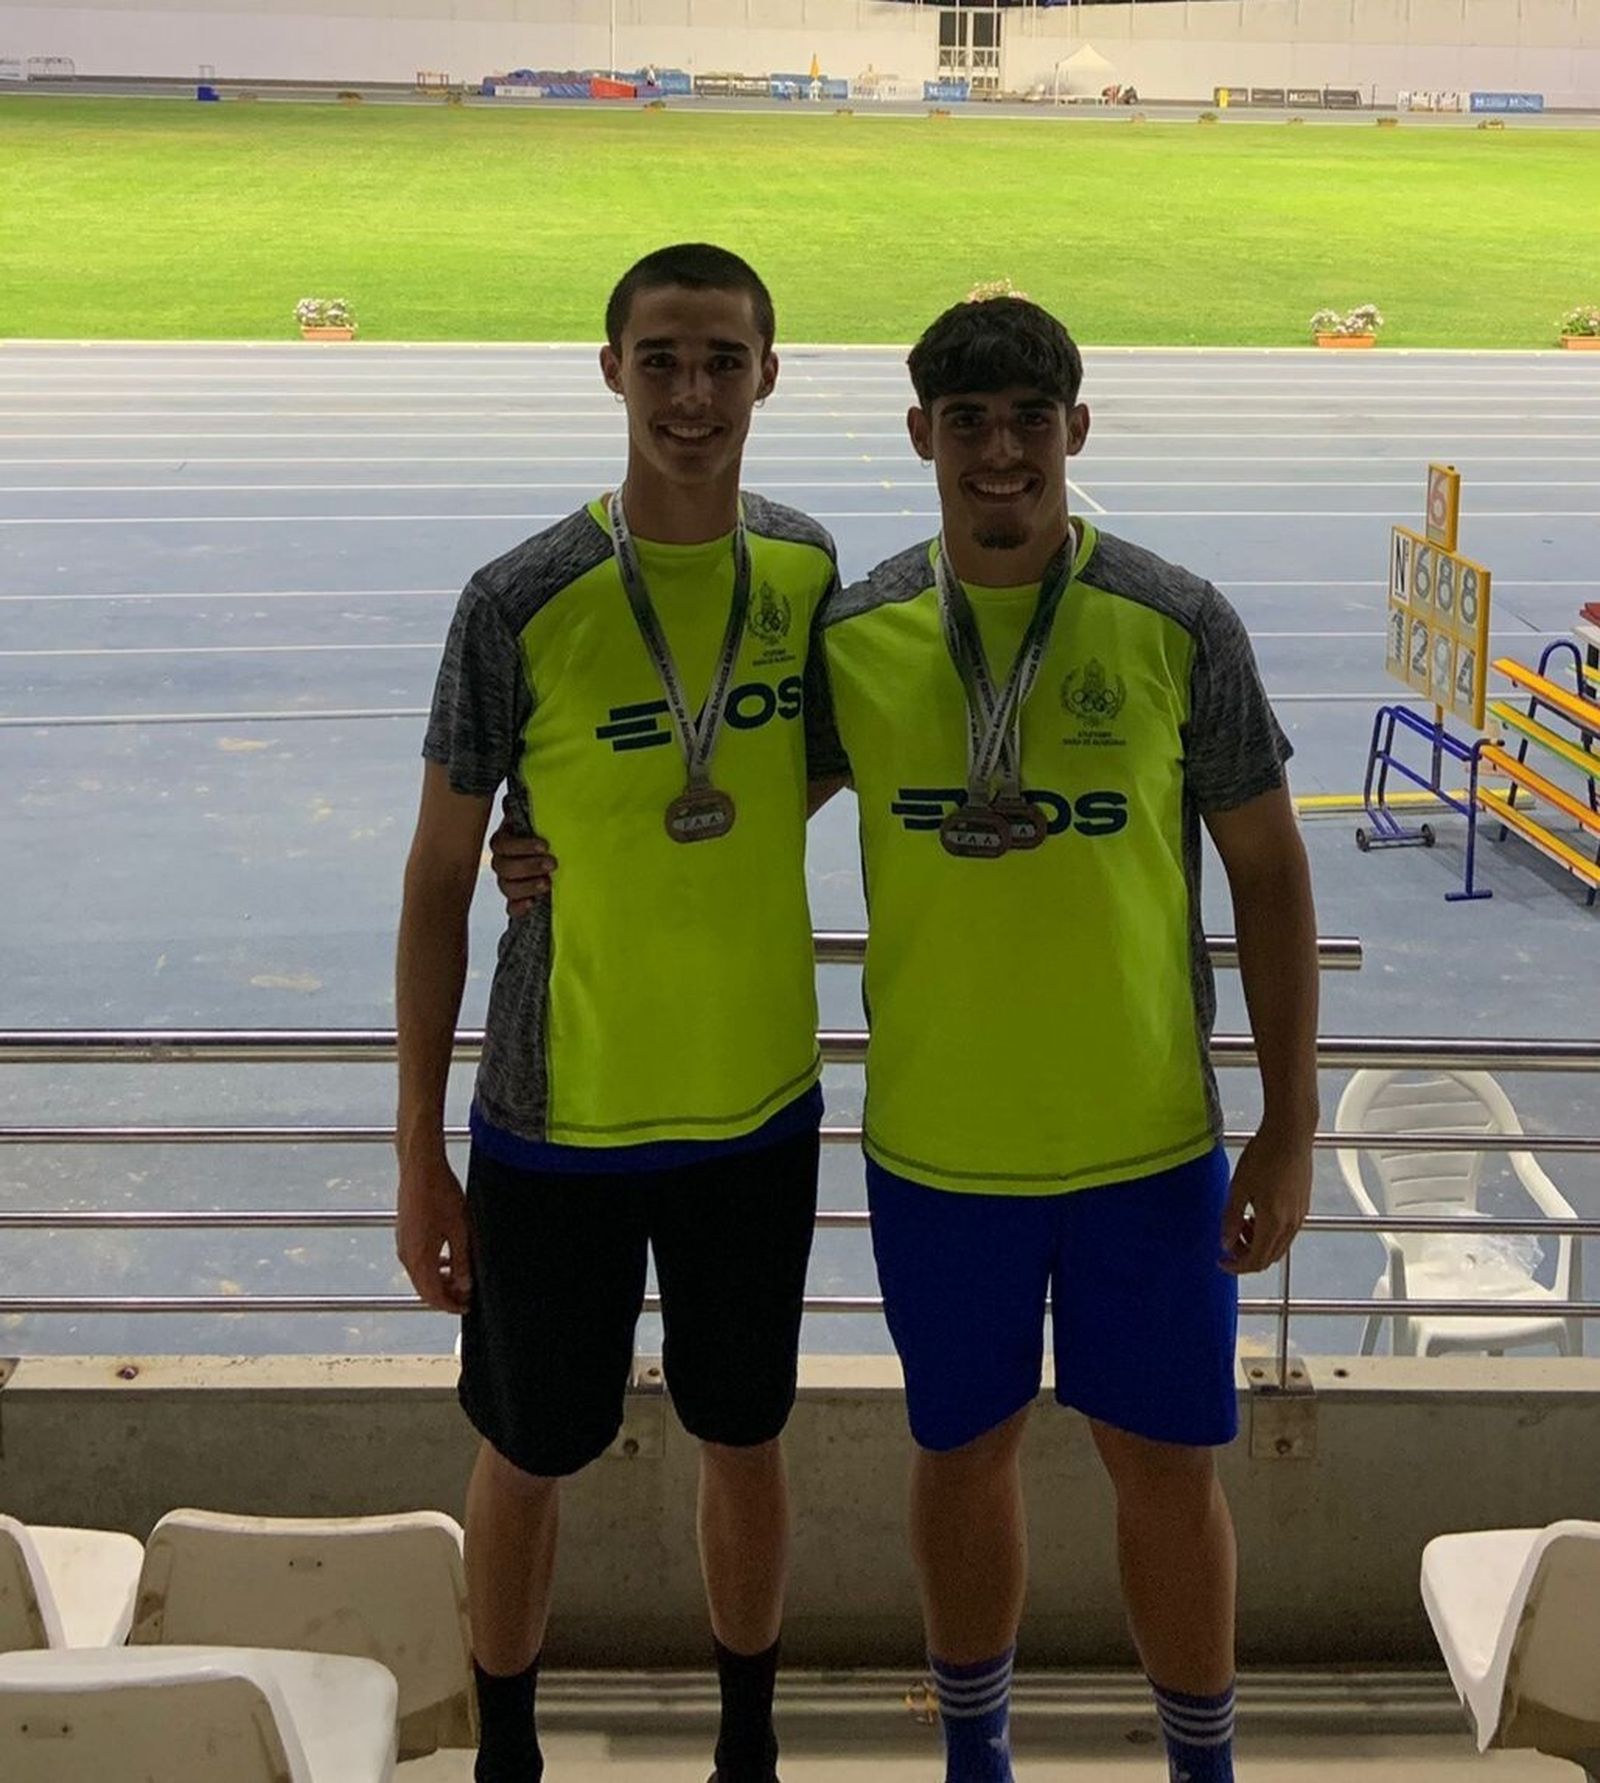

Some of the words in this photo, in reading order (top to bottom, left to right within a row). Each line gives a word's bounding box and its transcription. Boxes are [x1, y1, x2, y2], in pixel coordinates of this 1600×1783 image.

[1428, 470, 1448, 528] 6
[1414, 547, 1478, 625] 688
[1391, 608, 1477, 706] 1294
